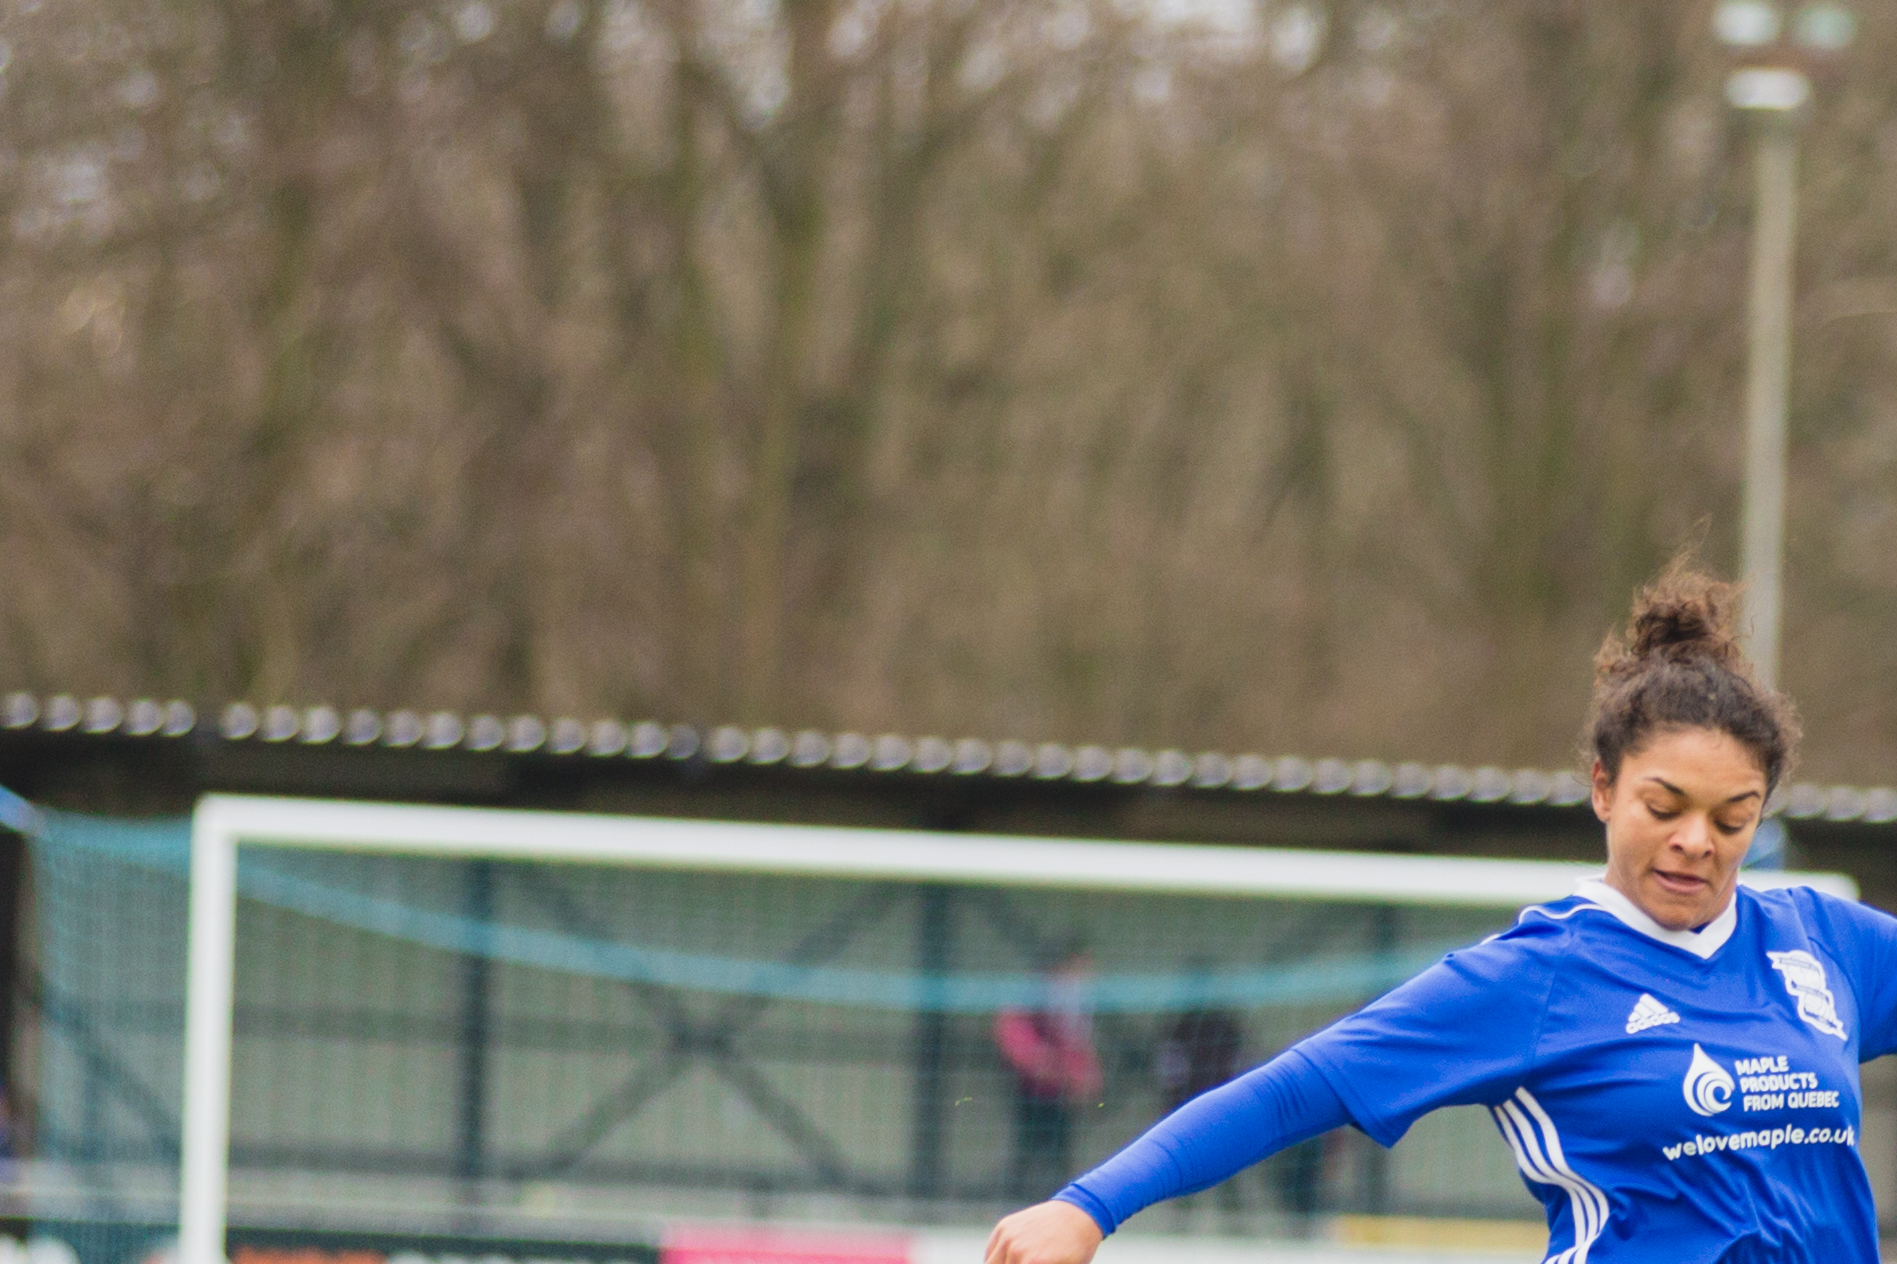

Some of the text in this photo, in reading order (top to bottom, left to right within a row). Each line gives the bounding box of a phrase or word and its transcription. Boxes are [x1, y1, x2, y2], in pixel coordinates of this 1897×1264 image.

[1626, 1011, 1680, 1034] adidas
[1735, 1055, 1789, 1075] MAPLE
[1740, 1072, 1818, 1093] PRODUCTS
[1743, 1091, 1840, 1112] FROM QUEBEC
[1662, 1123, 1855, 1161] welovemaple.co.uk
